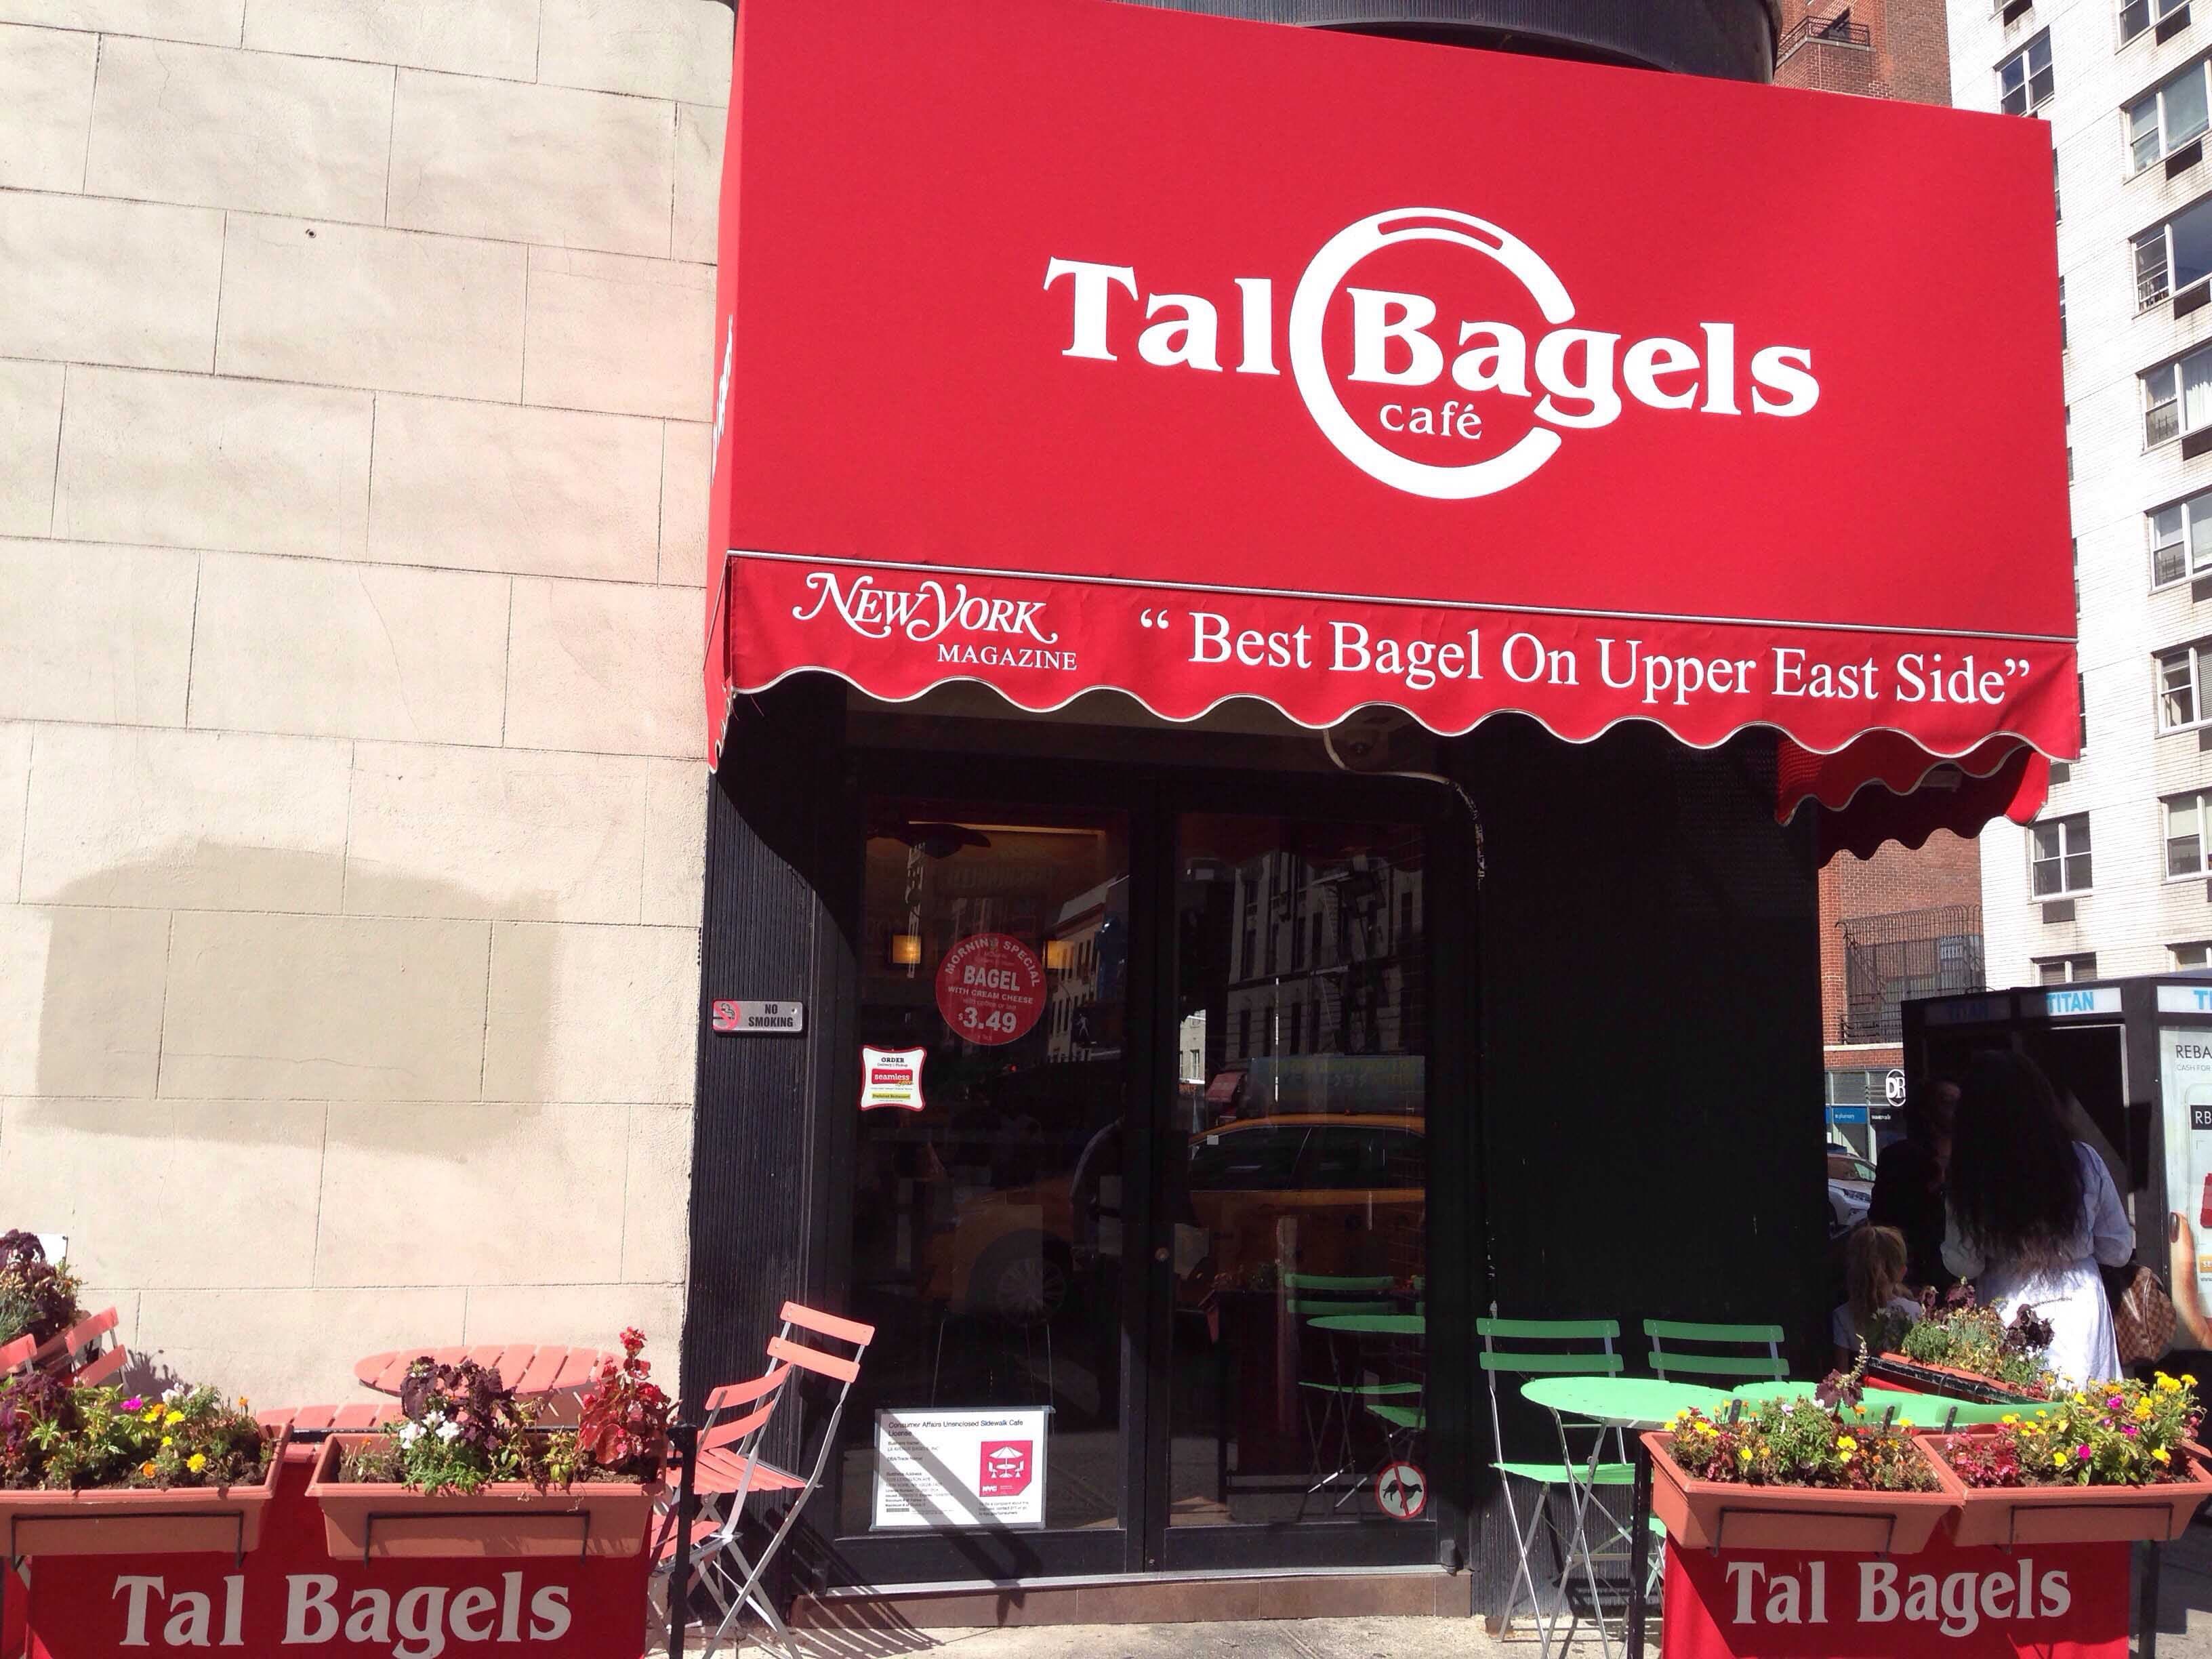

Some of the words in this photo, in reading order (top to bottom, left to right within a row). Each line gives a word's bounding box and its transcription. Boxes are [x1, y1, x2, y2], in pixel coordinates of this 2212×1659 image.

[1043, 256, 1281, 375] Tal
[1347, 287, 1820, 428] Bagels
[1379, 401, 1482, 439] café
[937, 644, 1078, 671] MAGAZINE
[1188, 612, 1312, 669] Best
[1328, 621, 1483, 690] Bagel
[1502, 633, 1580, 685] On
[1595, 638, 1757, 705] Upper
[1771, 648, 1879, 700] East
[1003, 941, 1040, 987] SPECIAL
[964, 965, 1020, 991] BAGEL
[948, 986, 969, 996] WITH
[971, 989, 1000, 1000] CREAM
[1002, 994, 1033, 1004] CHEESE
[2046, 991, 2095, 1013] TITAN
[748, 1017, 794, 1027] SMOKING
[764, 1004, 778, 1015] NO
[958, 1007, 1017, 1033] $3.49
[1725, 1560, 1828, 1624] Tal
[1857, 1558, 2071, 1637] Bagels
[112, 1574, 245, 1647] Tal
[281, 1571, 573, 1659] Bagels
